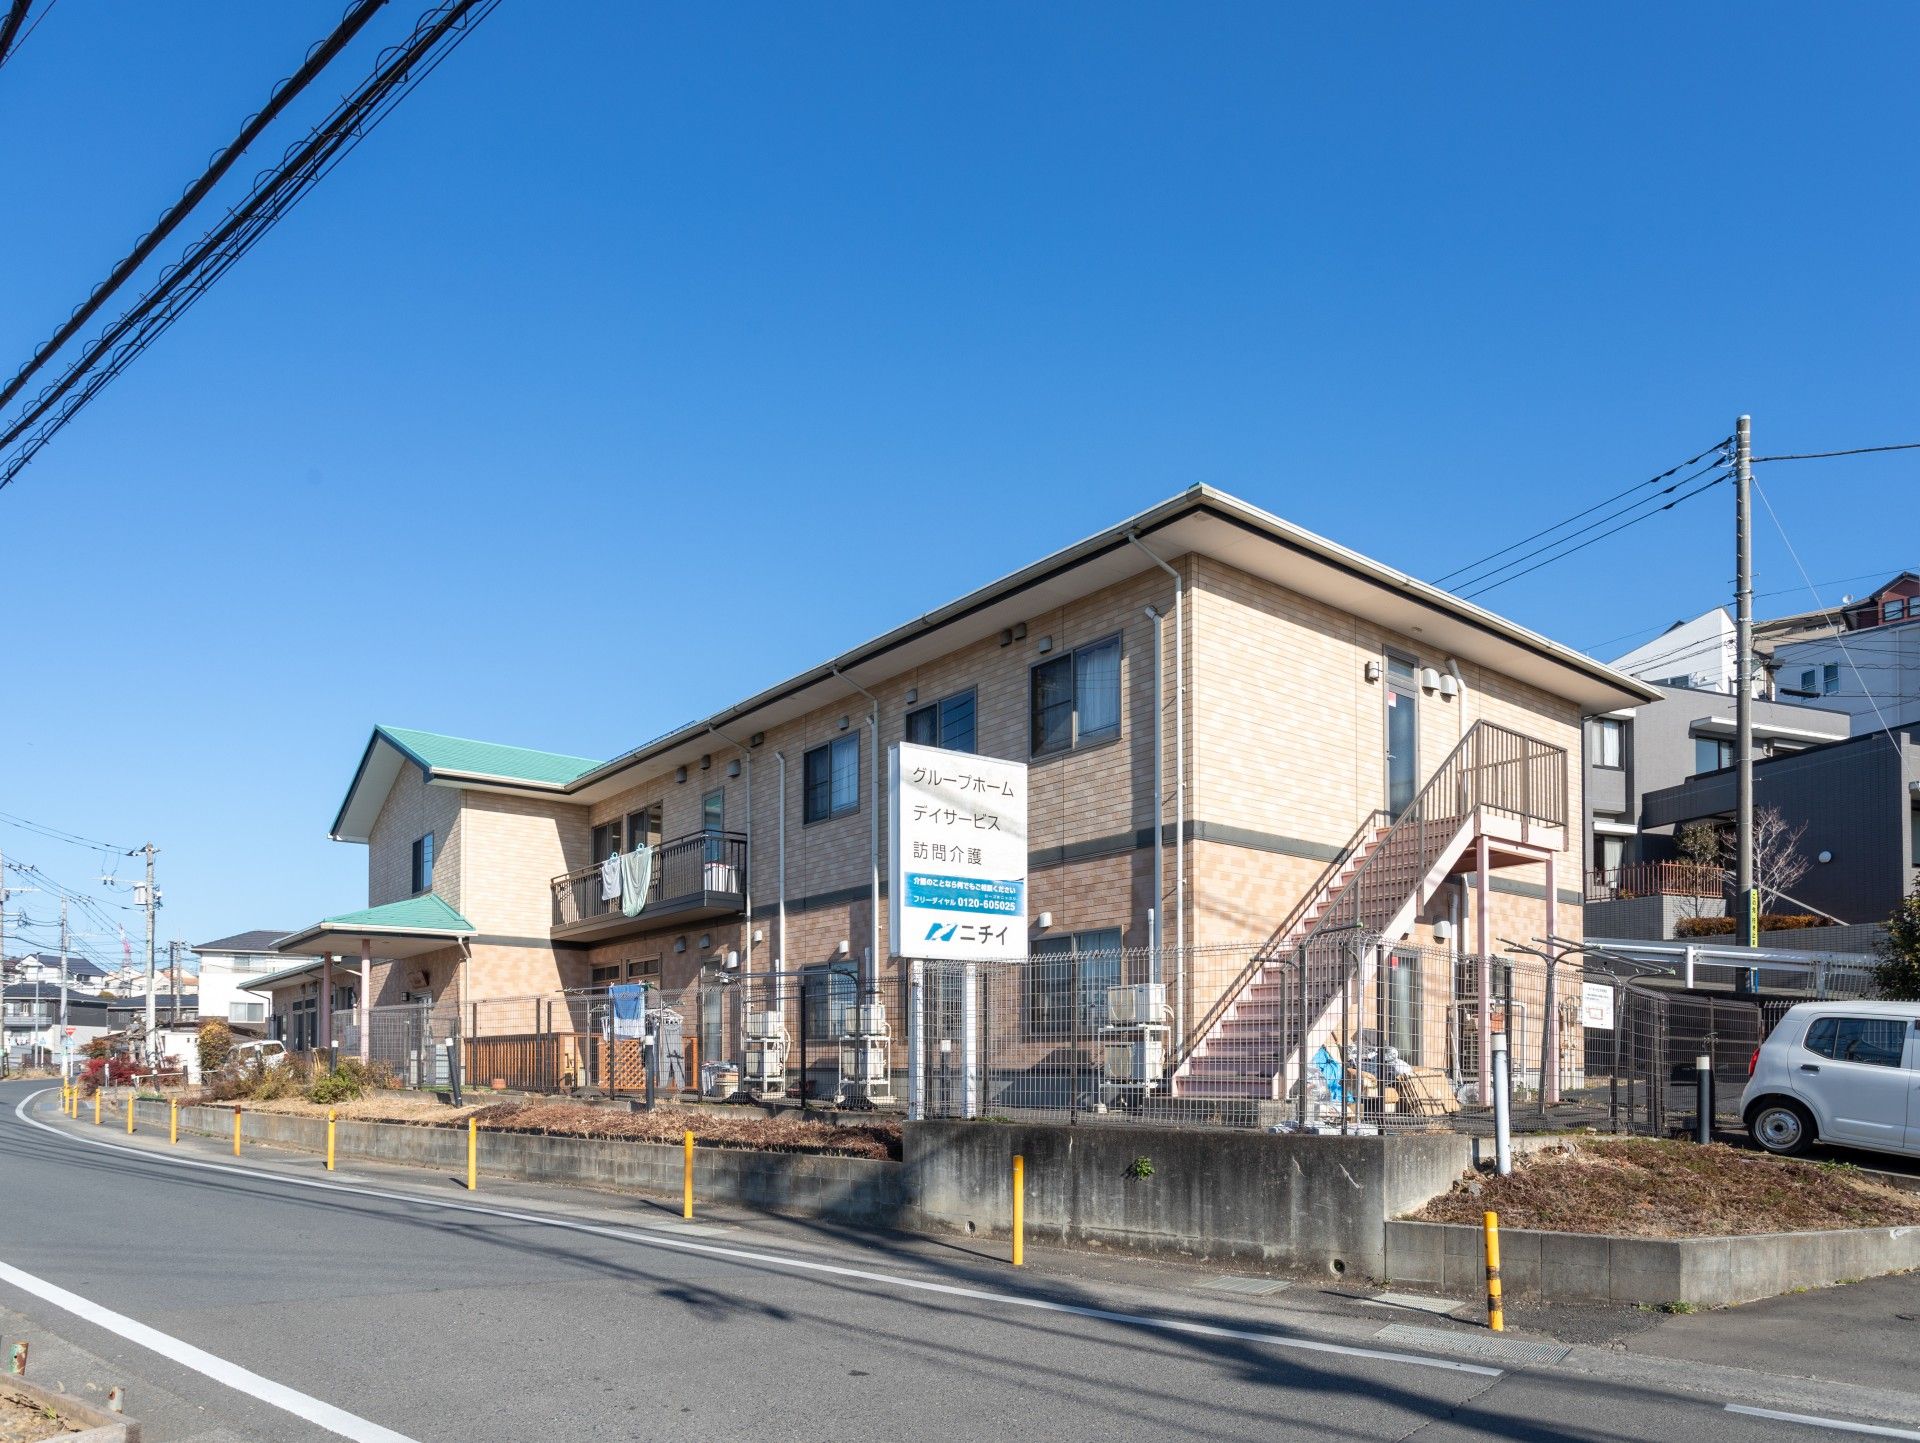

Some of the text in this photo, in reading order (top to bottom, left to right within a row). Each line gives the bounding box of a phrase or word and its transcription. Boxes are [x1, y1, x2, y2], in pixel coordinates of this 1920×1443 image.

[913, 767, 1014, 797] グループホーム
[913, 805, 1001, 831] デイサービス
[913, 841, 982, 865] 訪問介護
[913, 896, 1016, 911] フリーダイヤル 0120-605025
[960, 925, 1008, 946] ニチイ
